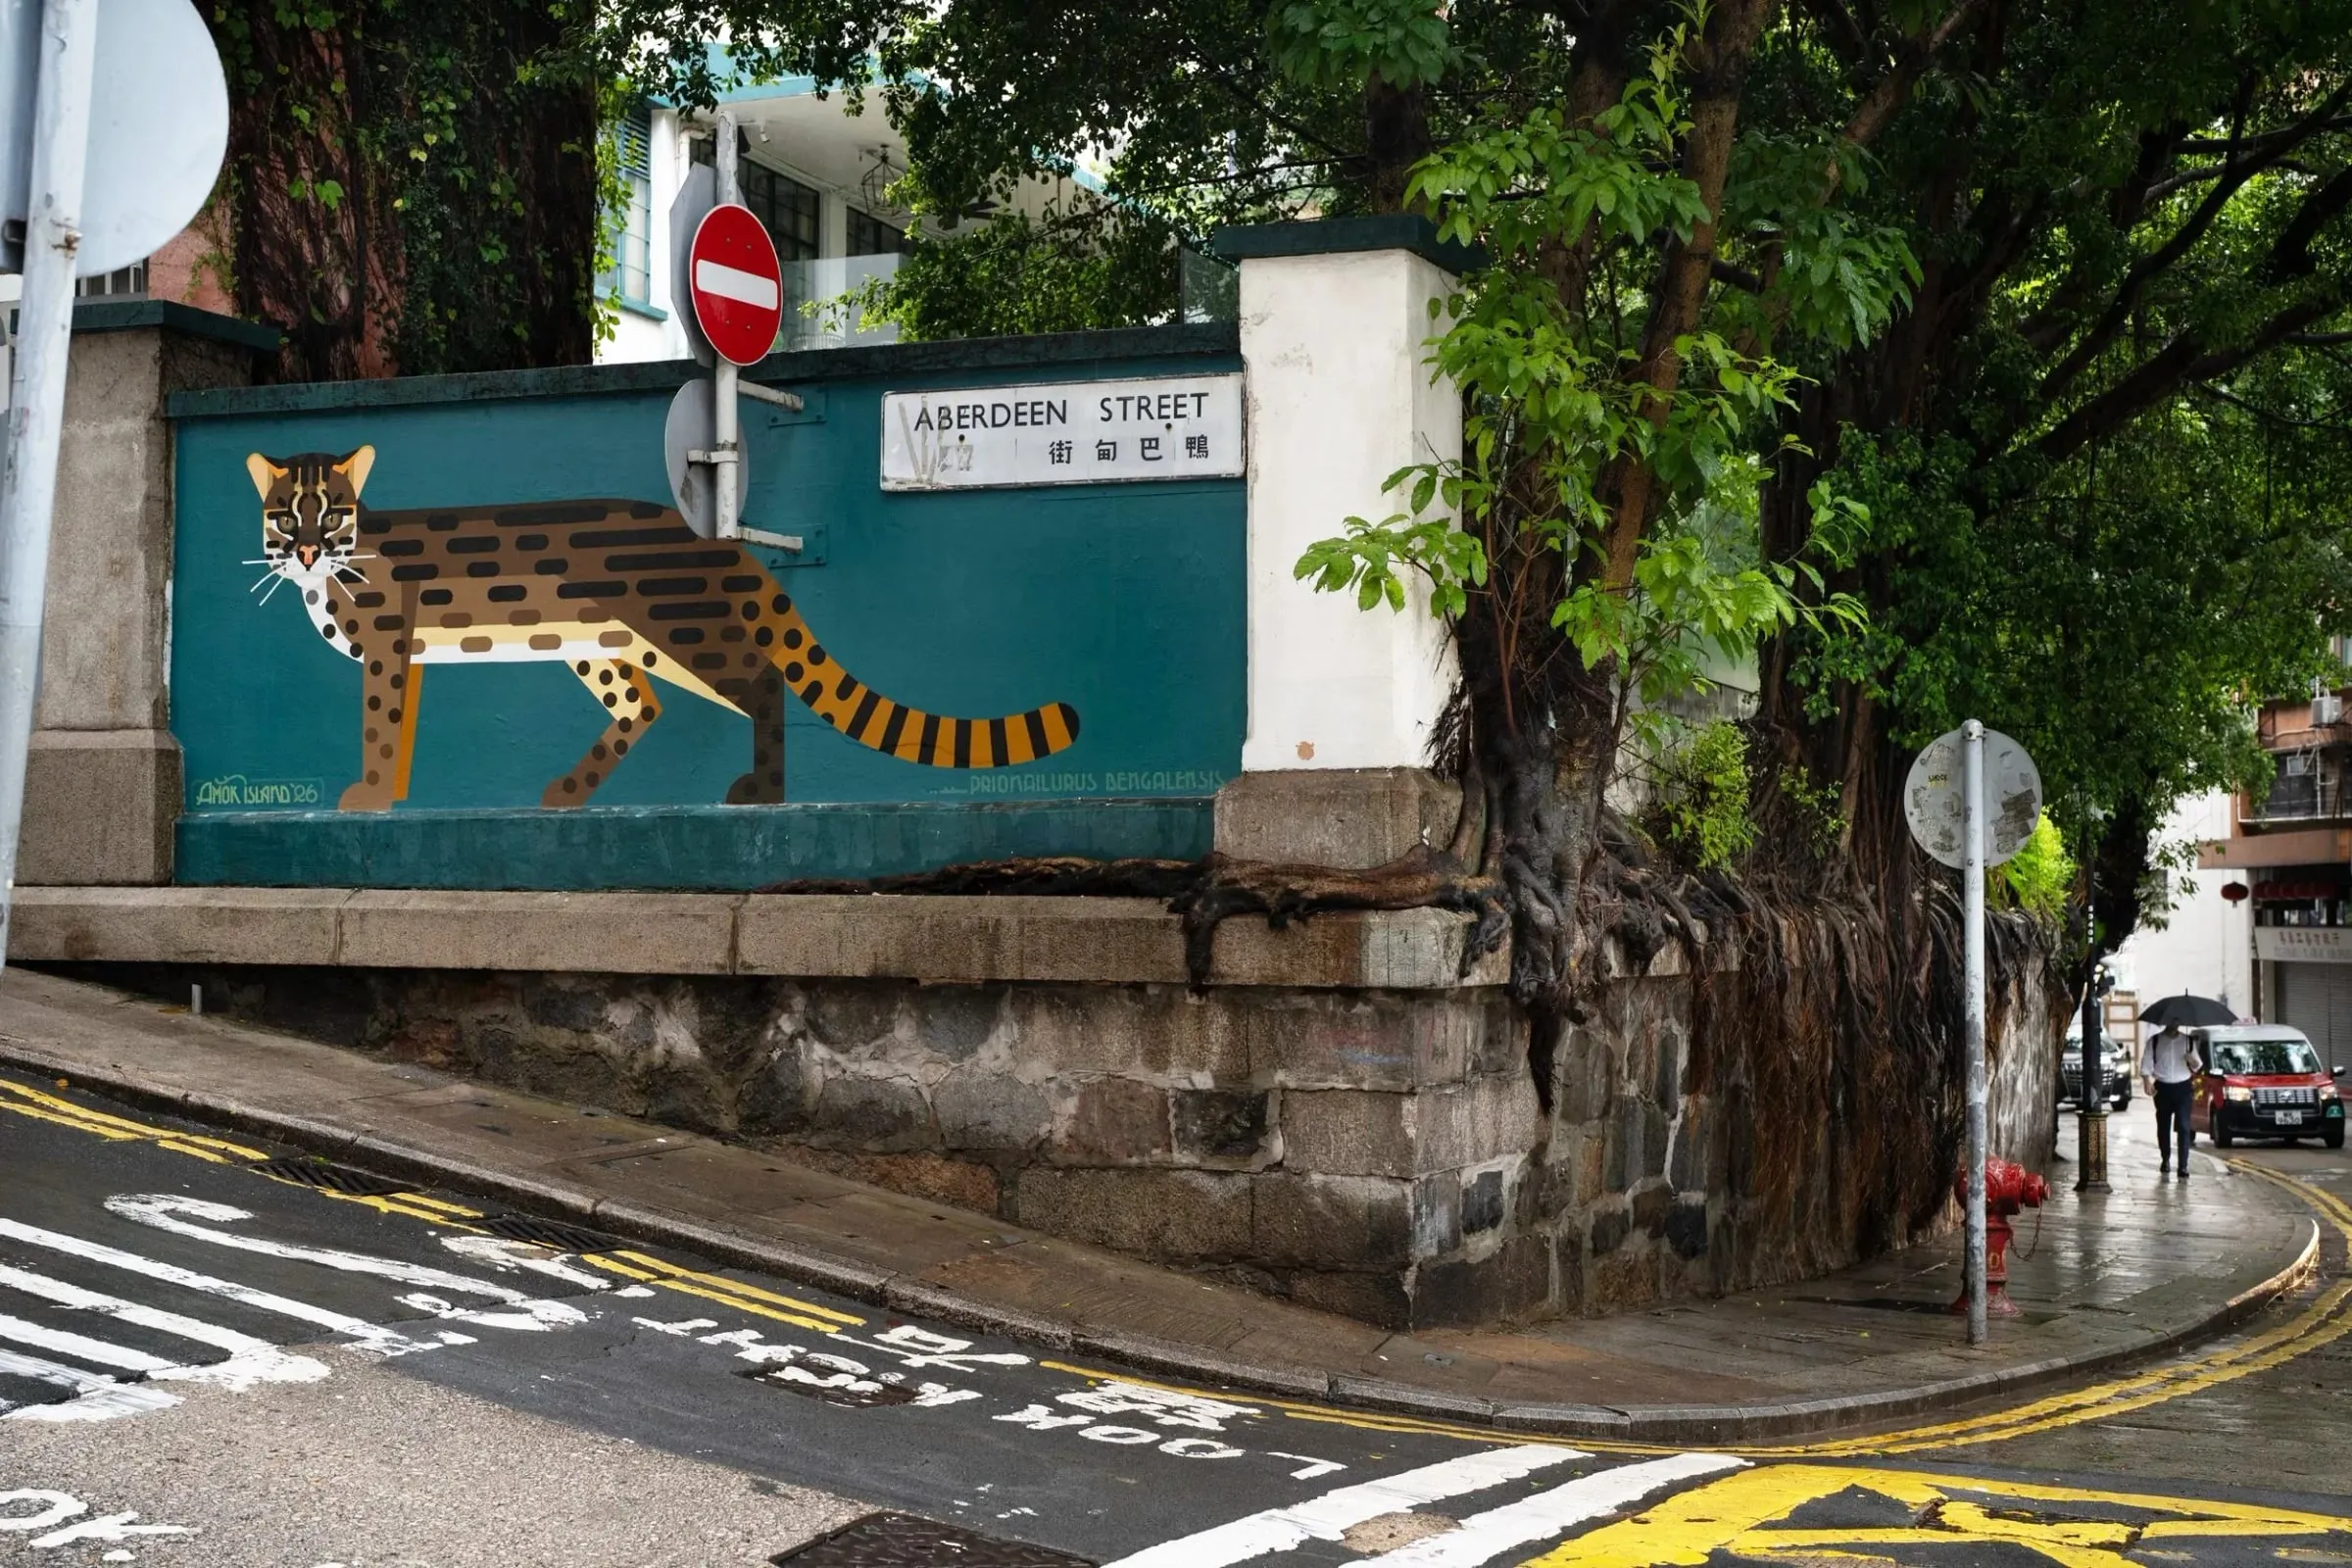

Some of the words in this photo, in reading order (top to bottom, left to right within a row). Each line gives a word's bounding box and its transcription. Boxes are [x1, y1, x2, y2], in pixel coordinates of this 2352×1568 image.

[913, 399, 1068, 432] ABERDEEN
[1099, 391, 1210, 422] STREET
[244, 784, 291, 805] ISLAND
[969, 772, 1099, 795] PRIONAILURUS
[1105, 769, 1226, 792] BENGALENSIS
